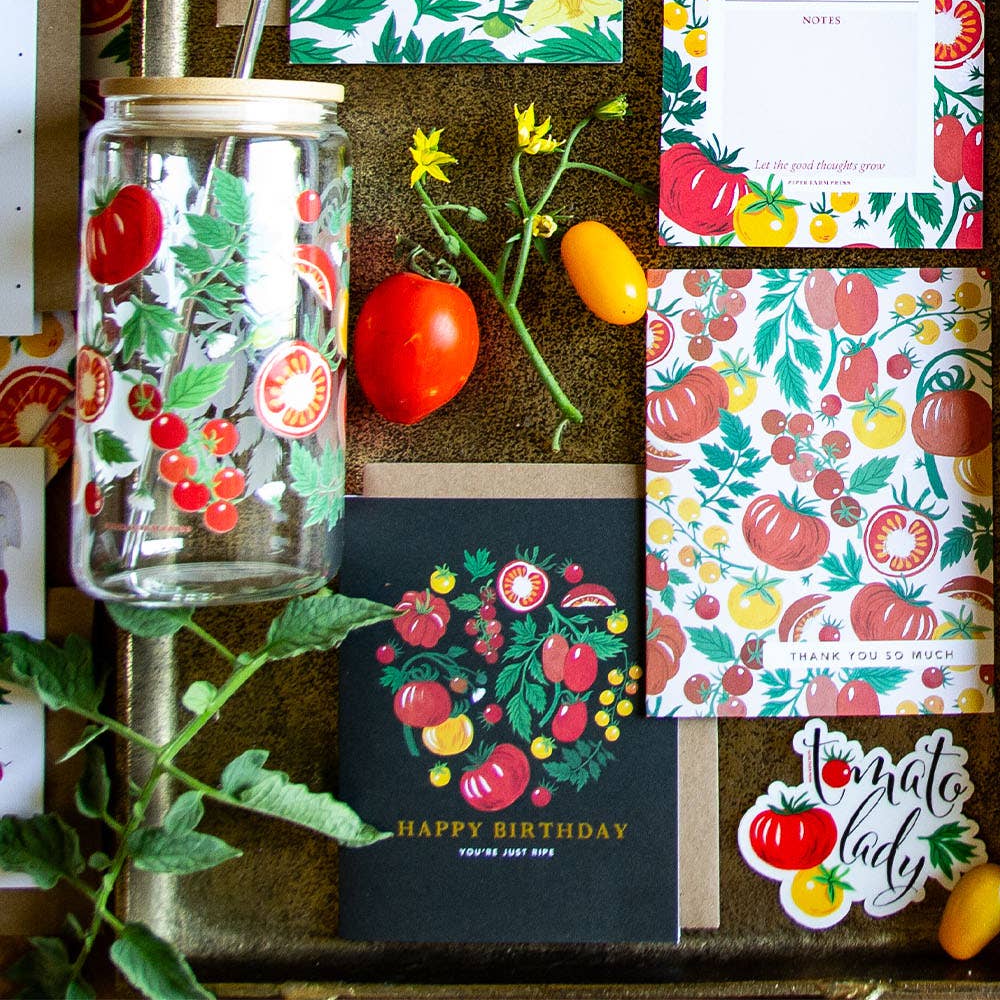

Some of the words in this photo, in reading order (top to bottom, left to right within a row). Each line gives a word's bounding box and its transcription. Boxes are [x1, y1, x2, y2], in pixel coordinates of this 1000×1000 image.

[802, 16, 841, 25] NOTES
[754, 160, 770, 170] Let
[773, 160, 789, 170] the
[791, 160, 815, 173] good
[816, 160, 858, 173] thoughts
[858, 163, 886, 173] grow
[790, 652, 841, 661] THANK
[849, 651, 878, 660] YOU
[886, 651, 904, 660] SO
[912, 650, 954, 660] MUCH
[397, 820, 483, 838] HAPPY
[493, 822, 628, 840] BIRTHDAY
[458, 847, 499, 857] YOU'RE
[502, 847, 528, 857] JUST
[531, 847, 555, 857] RIPE
[839, 786, 925, 907] lady
